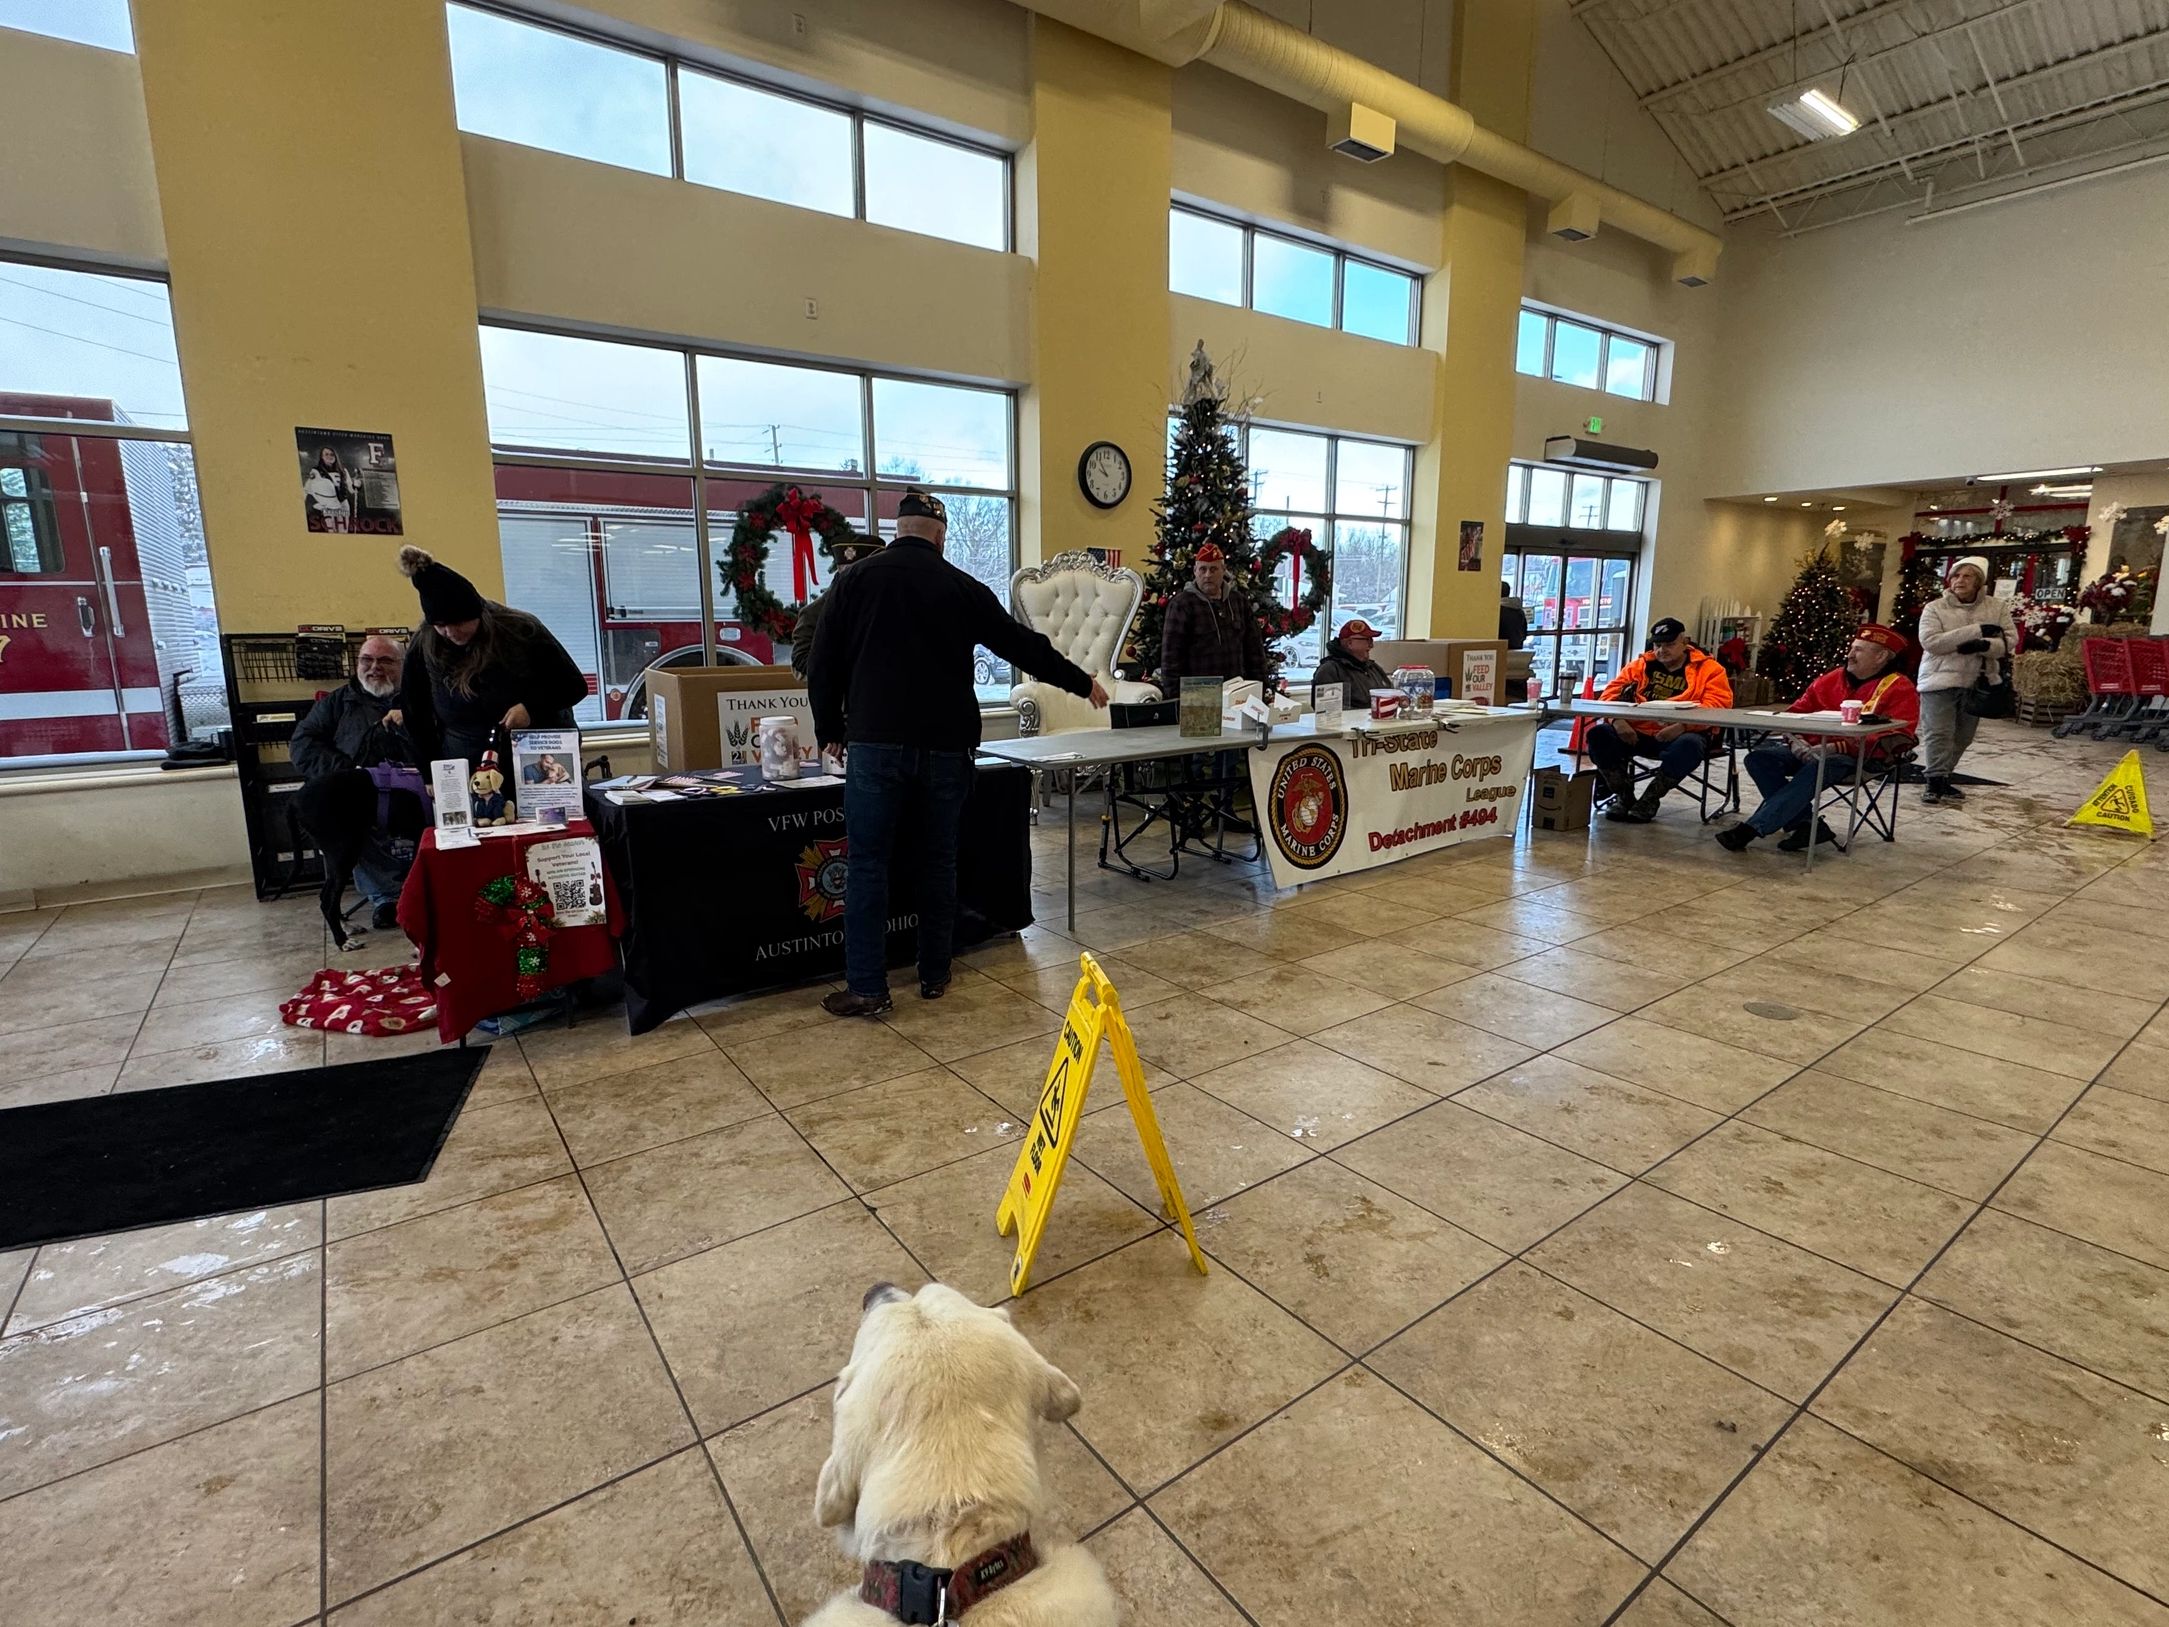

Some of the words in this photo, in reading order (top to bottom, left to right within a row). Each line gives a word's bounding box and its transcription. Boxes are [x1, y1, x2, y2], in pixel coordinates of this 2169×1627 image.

[2036, 590, 2064, 598] OPEN
[0, 613, 49, 629] INE
[1472, 675, 1485, 683] OUR
[1473, 665, 1490, 674] FEED
[1472, 683, 1493, 691] VALLEY
[727, 698, 777, 710] THANK
[780, 696, 808, 708] YOU
[1278, 757, 1307, 799] UNITED
[1311, 757, 1336, 790] STATES
[1390, 759, 1447, 791] Marine
[1451, 754, 1502, 782] Corps
[1466, 785, 1516, 802] League
[2125, 785, 2139, 814] CUIDADO
[768, 813, 808, 832] VFW
[814, 807, 845, 825] POS
[2096, 812, 2130, 822] CAUTION
[1281, 824, 1315, 857] MARINE
[1319, 814, 1338, 851] CORPS
[1368, 814, 1456, 852] Detachment
[1459, 807, 1497, 829] #494
[756, 930, 844, 961] AUSTINTO
[1063, 1020, 1084, 1065] CAUTION
